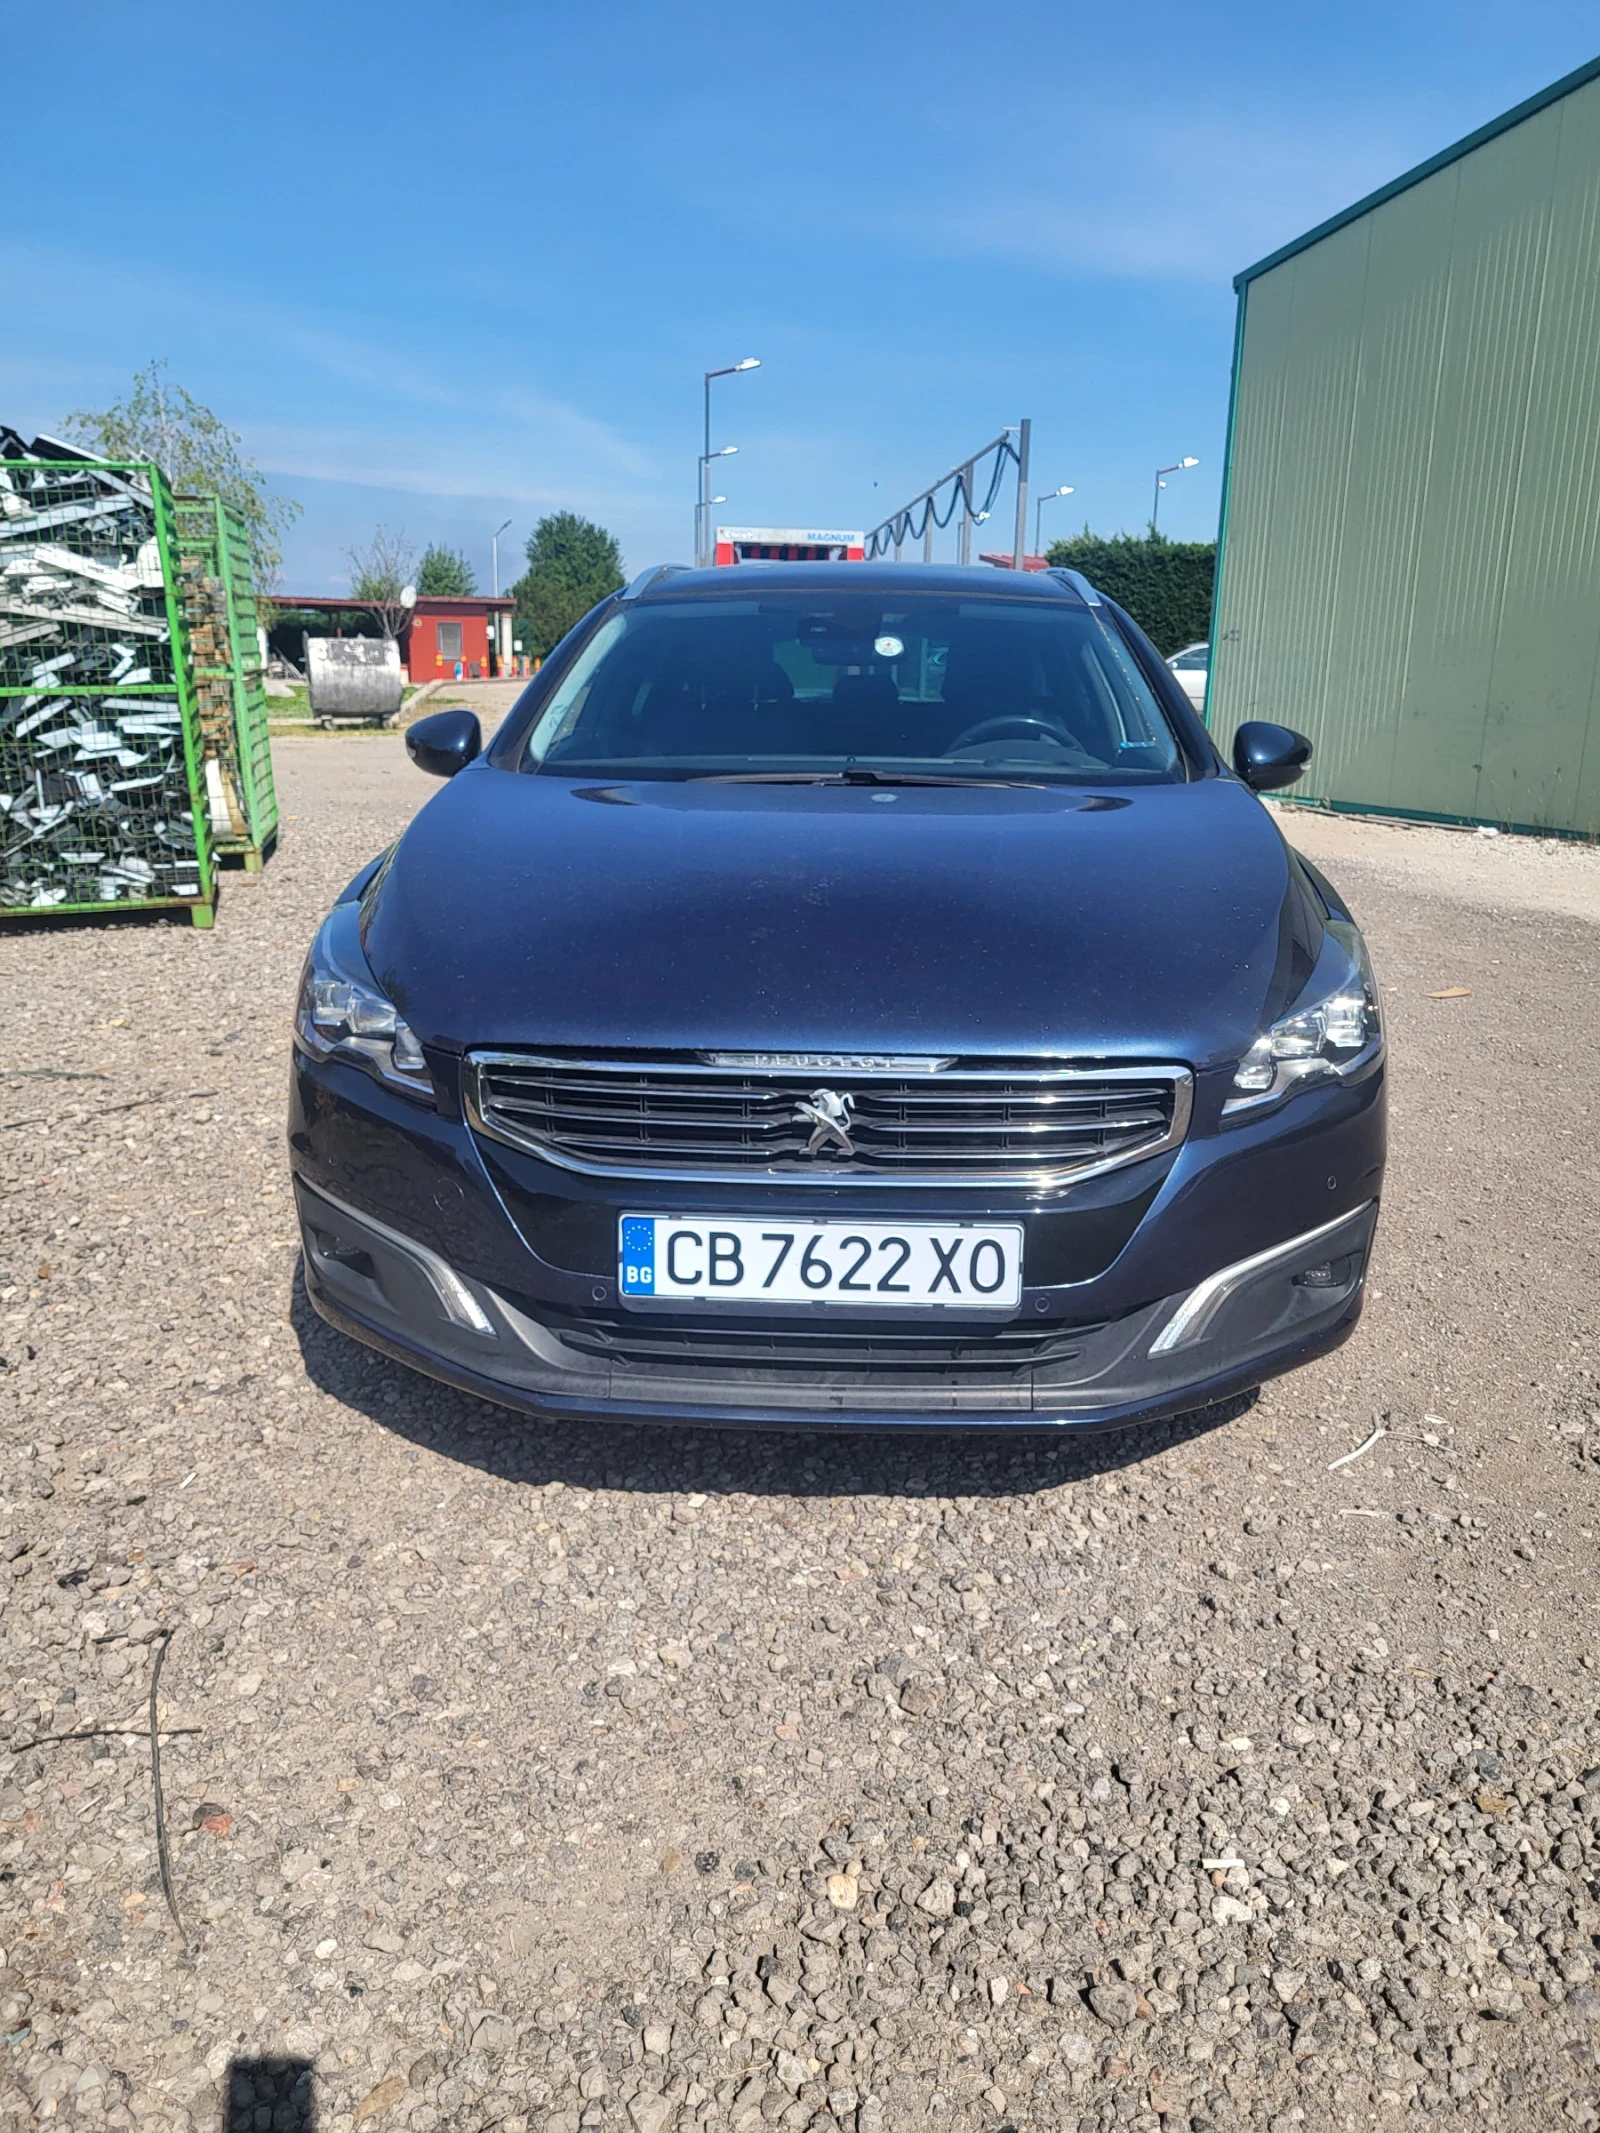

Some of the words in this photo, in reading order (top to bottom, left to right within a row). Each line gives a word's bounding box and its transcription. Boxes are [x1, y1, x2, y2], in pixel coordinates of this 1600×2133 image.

[807, 533, 855, 542] MAGNUM
[754, 1054, 895, 1068] PEUGEOT
[666, 1230, 745, 1286] CB
[761, 1233, 911, 1292] 7622
[627, 1266, 652, 1284] BG
